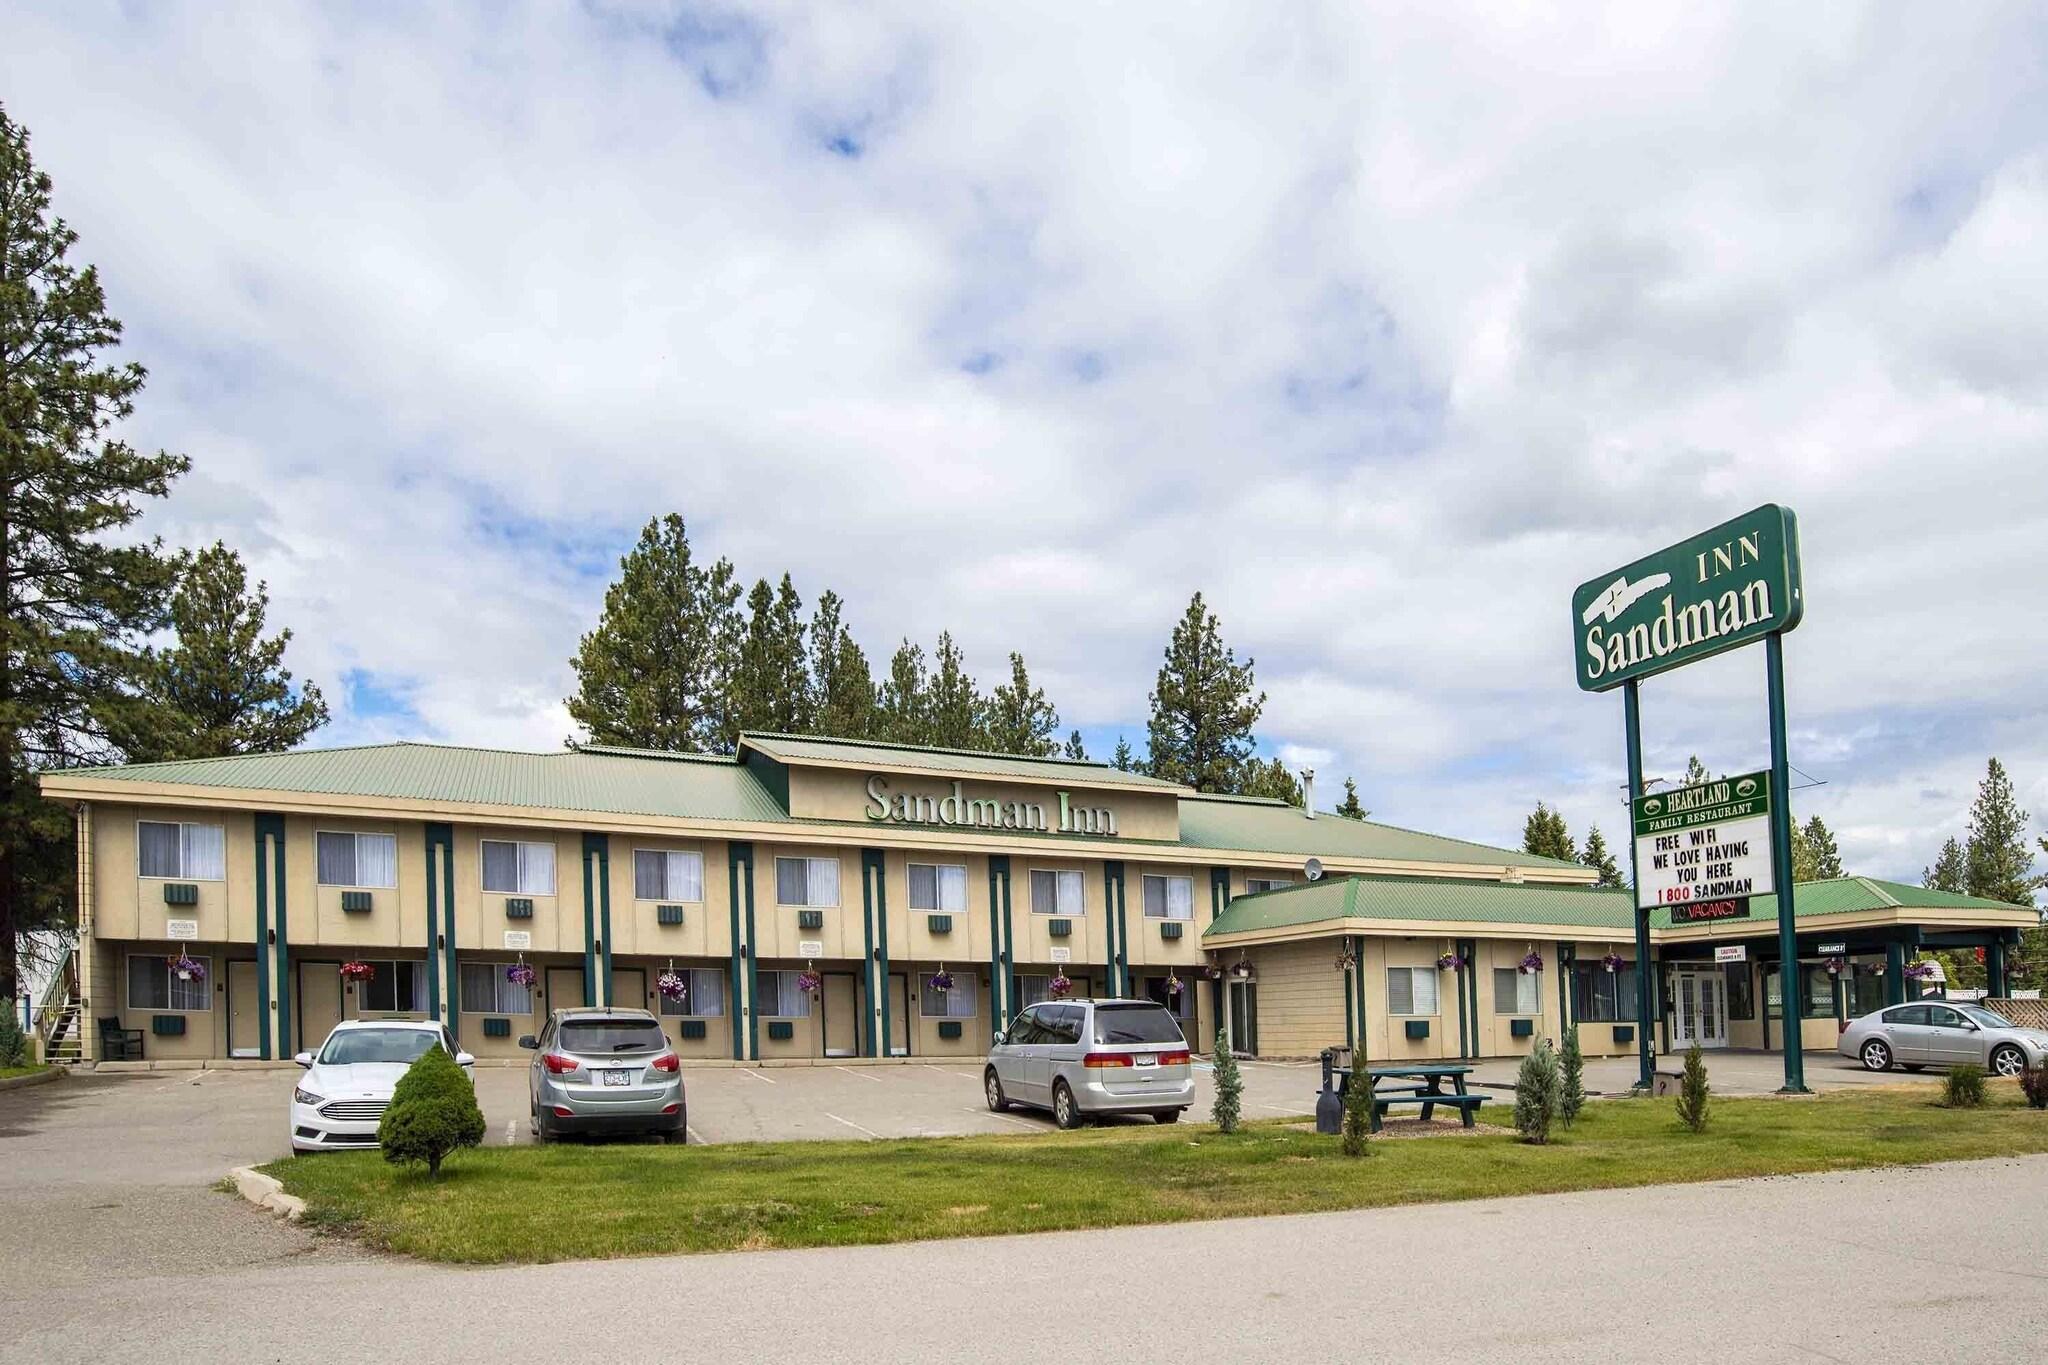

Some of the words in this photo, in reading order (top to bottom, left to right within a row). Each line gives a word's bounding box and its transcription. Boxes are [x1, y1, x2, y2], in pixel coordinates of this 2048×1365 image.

[1696, 531, 1759, 583] INN
[1586, 578, 1773, 679] Sandman
[864, 774, 1048, 832] Sandman
[1056, 791, 1119, 836] Inn
[1667, 782, 1730, 813] HEARTLAND
[1649, 815, 1683, 831] FAMILY
[1687, 803, 1752, 824] RESTAURANT
[1653, 854, 1668, 870] WE
[1674, 849, 1701, 867] LOVE
[1706, 841, 1749, 862] HAVING
[1655, 834, 1680, 852] FREE
[1677, 867, 1698, 883] YOU
[1706, 862, 1733, 880] HERE
[1658, 889, 1663, 904] 1
[1666, 886, 1690, 902] 800
[1694, 878, 1752, 898] SANDMAN
[1672, 906, 1686, 920] NO
[1688, 900, 1736, 919] VACANCY
